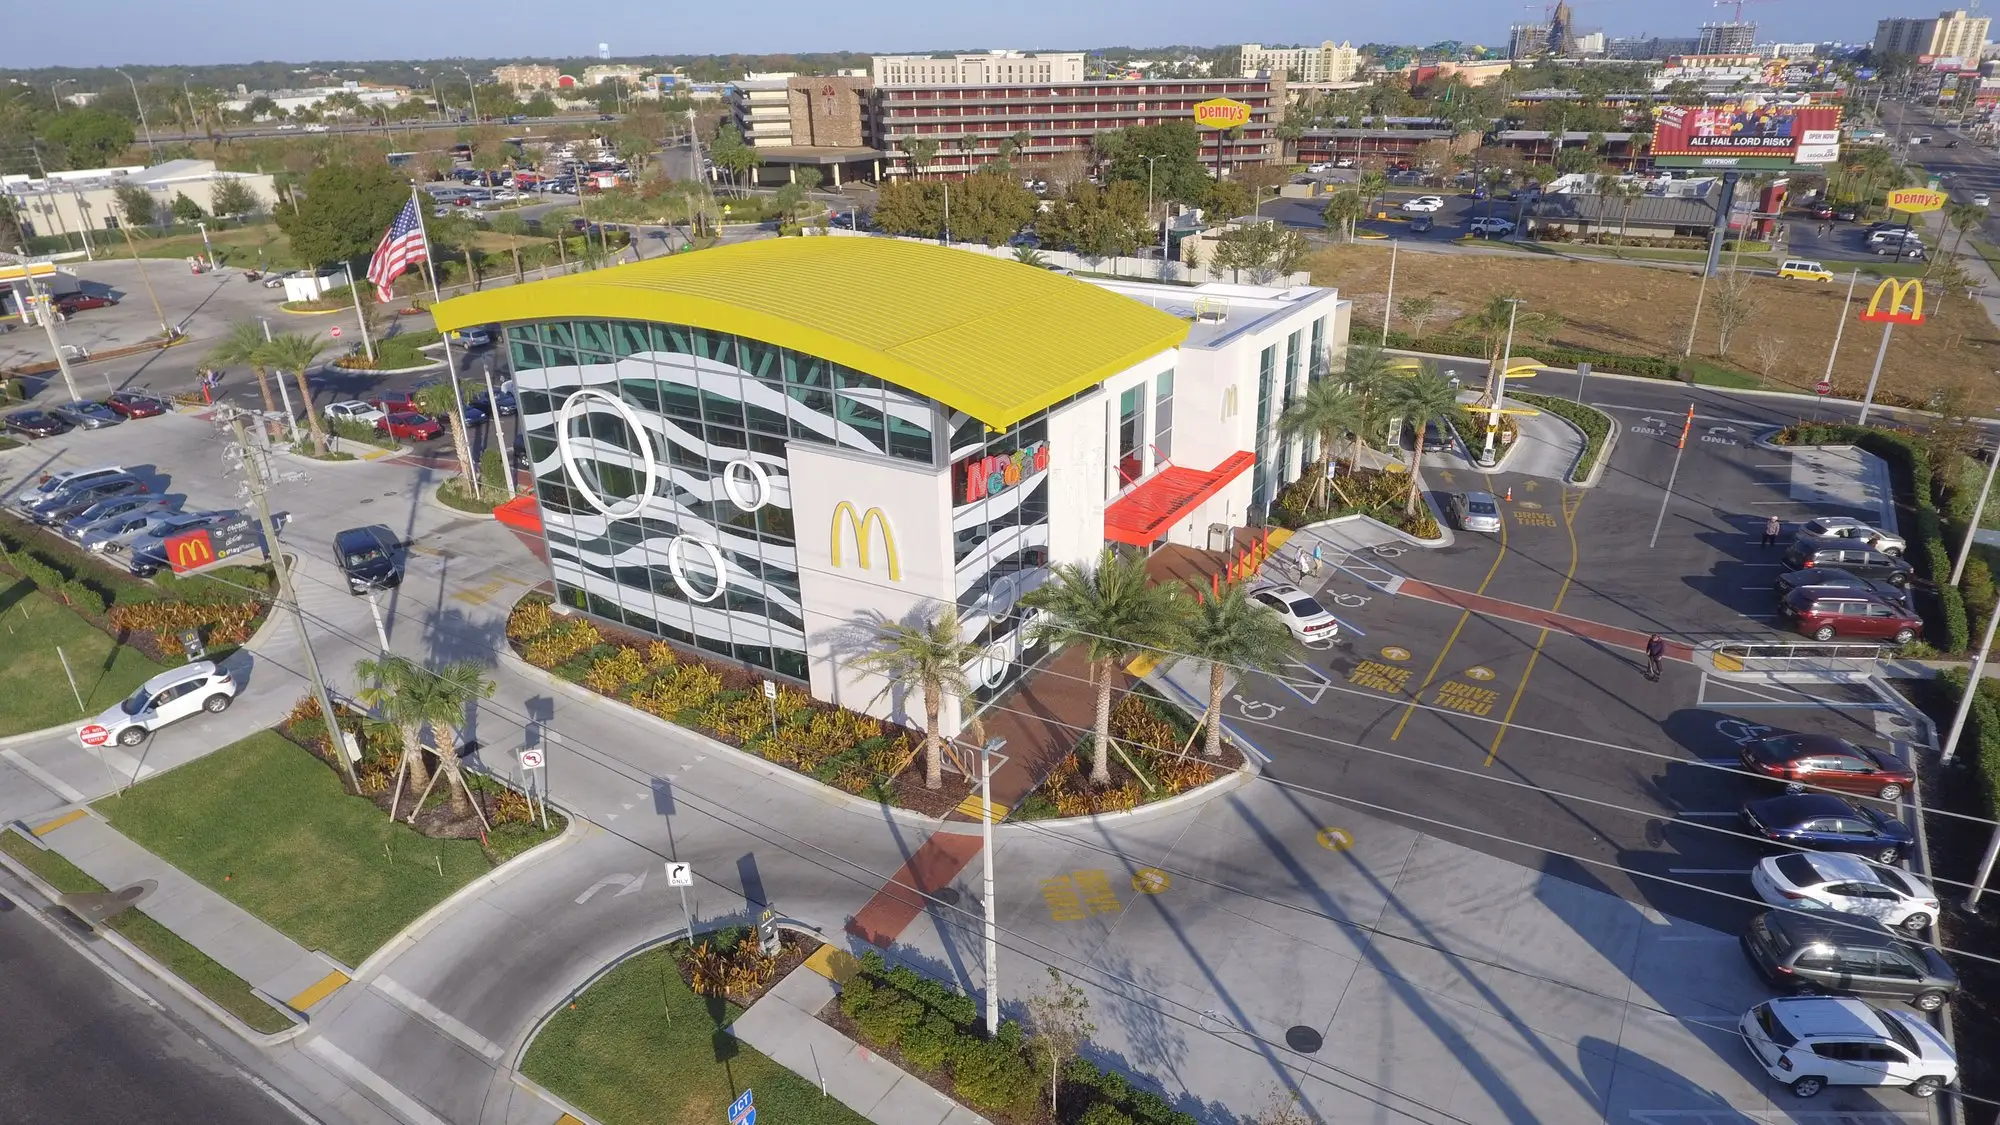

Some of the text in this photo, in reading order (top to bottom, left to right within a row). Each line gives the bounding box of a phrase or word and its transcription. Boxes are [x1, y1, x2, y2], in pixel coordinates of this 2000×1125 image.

[1199, 105, 1244, 120] Denny's
[1711, 138, 1732, 146] HAIL
[1734, 138, 1760, 146] LORD
[1763, 138, 1792, 146] RISKY
[1895, 194, 1940, 206] Denny's
[1631, 426, 1667, 436] ONLY
[1701, 435, 1738, 446] ONLY
[1513, 511, 1553, 520] DRIVE
[1517, 518, 1557, 528] THRU
[1356, 660, 1414, 682] DRIVE
[1349, 671, 1405, 694] THRU
[1439, 681, 1500, 704] DRIVE
[1433, 693, 1494, 716] THRU
[732, 1094, 749, 1117] JCT
